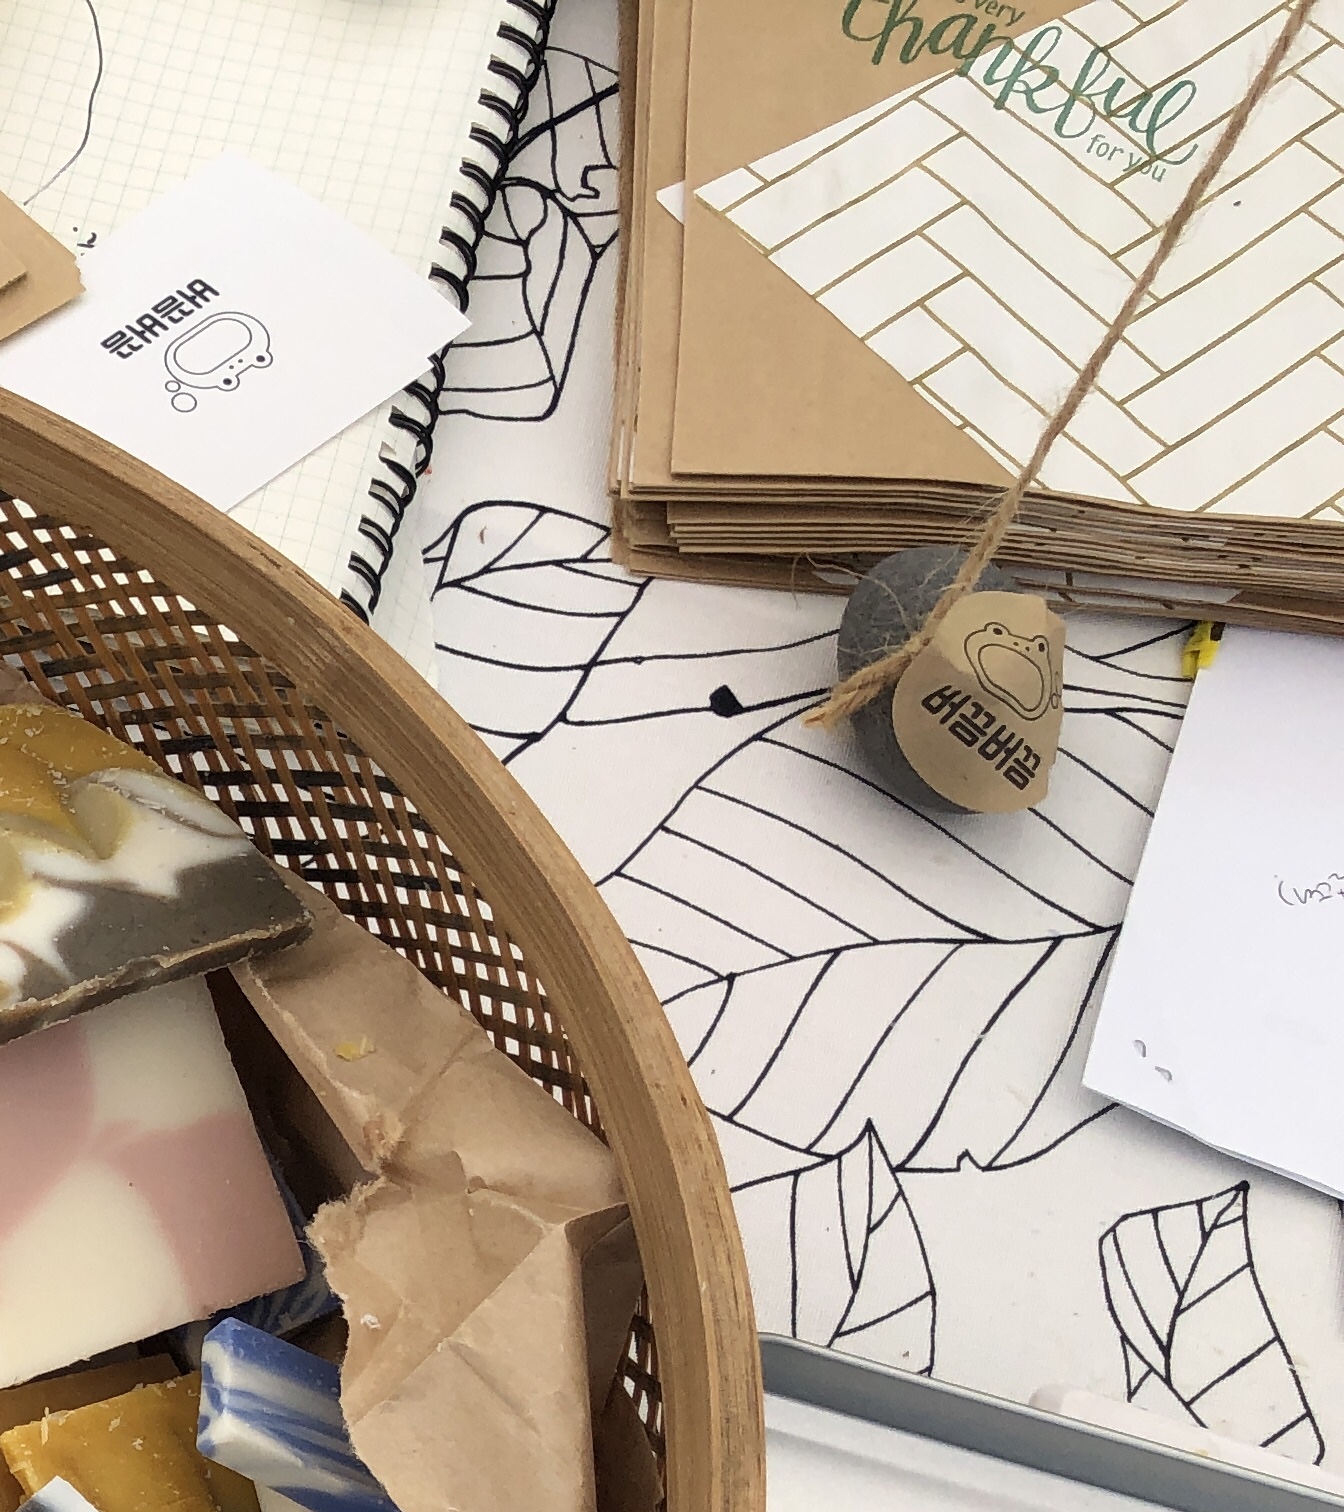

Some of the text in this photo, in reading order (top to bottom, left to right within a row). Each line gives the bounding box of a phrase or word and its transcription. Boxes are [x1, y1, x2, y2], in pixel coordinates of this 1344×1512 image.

[1086, 134, 1167, 183] for you
[100, 278, 221, 360] 버끔버끔
[921, 685, 1042, 791] 버끔버끔
